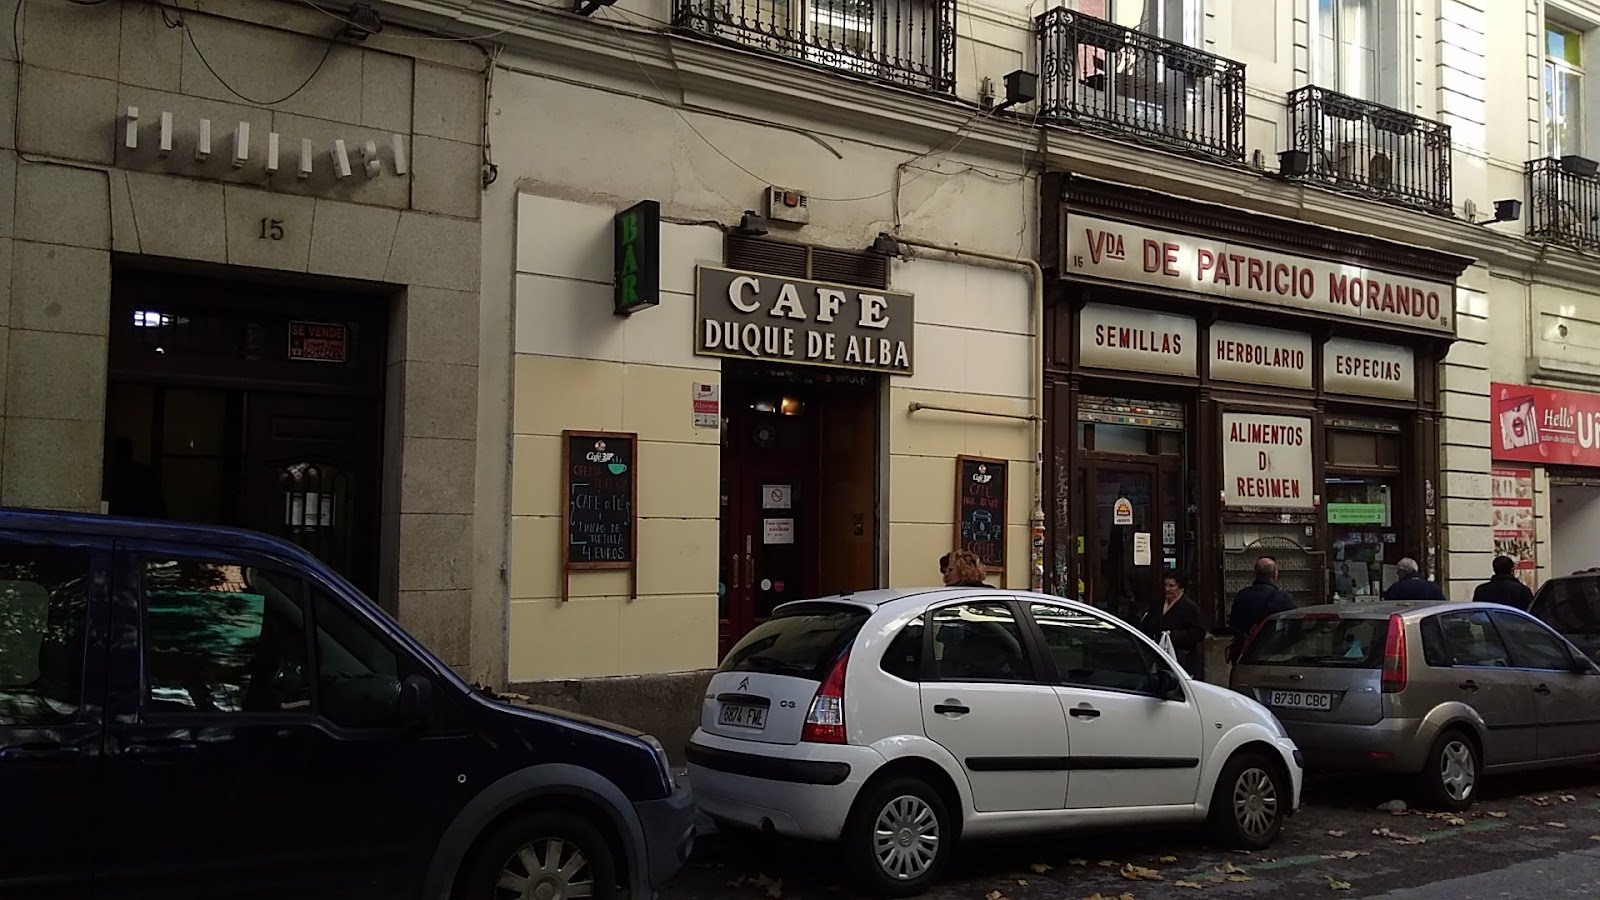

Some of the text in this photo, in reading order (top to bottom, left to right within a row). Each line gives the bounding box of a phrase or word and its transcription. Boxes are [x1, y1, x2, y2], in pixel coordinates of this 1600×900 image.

[258, 217, 285, 241] 15
[620, 212, 640, 305] BAR
[1143, 238, 1180, 277] DE
[1197, 248, 1315, 299] PATRICIO
[1329, 273, 1440, 320] MORANDO
[728, 275, 891, 330] CAFE
[291, 324, 343, 339] SE VENDE
[704, 318, 910, 368] DUQUE DE ALBA
[1095, 324, 1182, 355] SEMILLAS
[1216, 339, 1304, 370] HERBOLARIO
[1335, 354, 1401, 381] ESPECIAS
[1544, 407, 1574, 428] Hello
[1230, 421, 1303, 446] ALIMENTOS
[1236, 476, 1300, 499] REGIMEN
[582, 545, 625, 561] 4 EUROS
[1274, 692, 1328, 707] 8730 CBC
